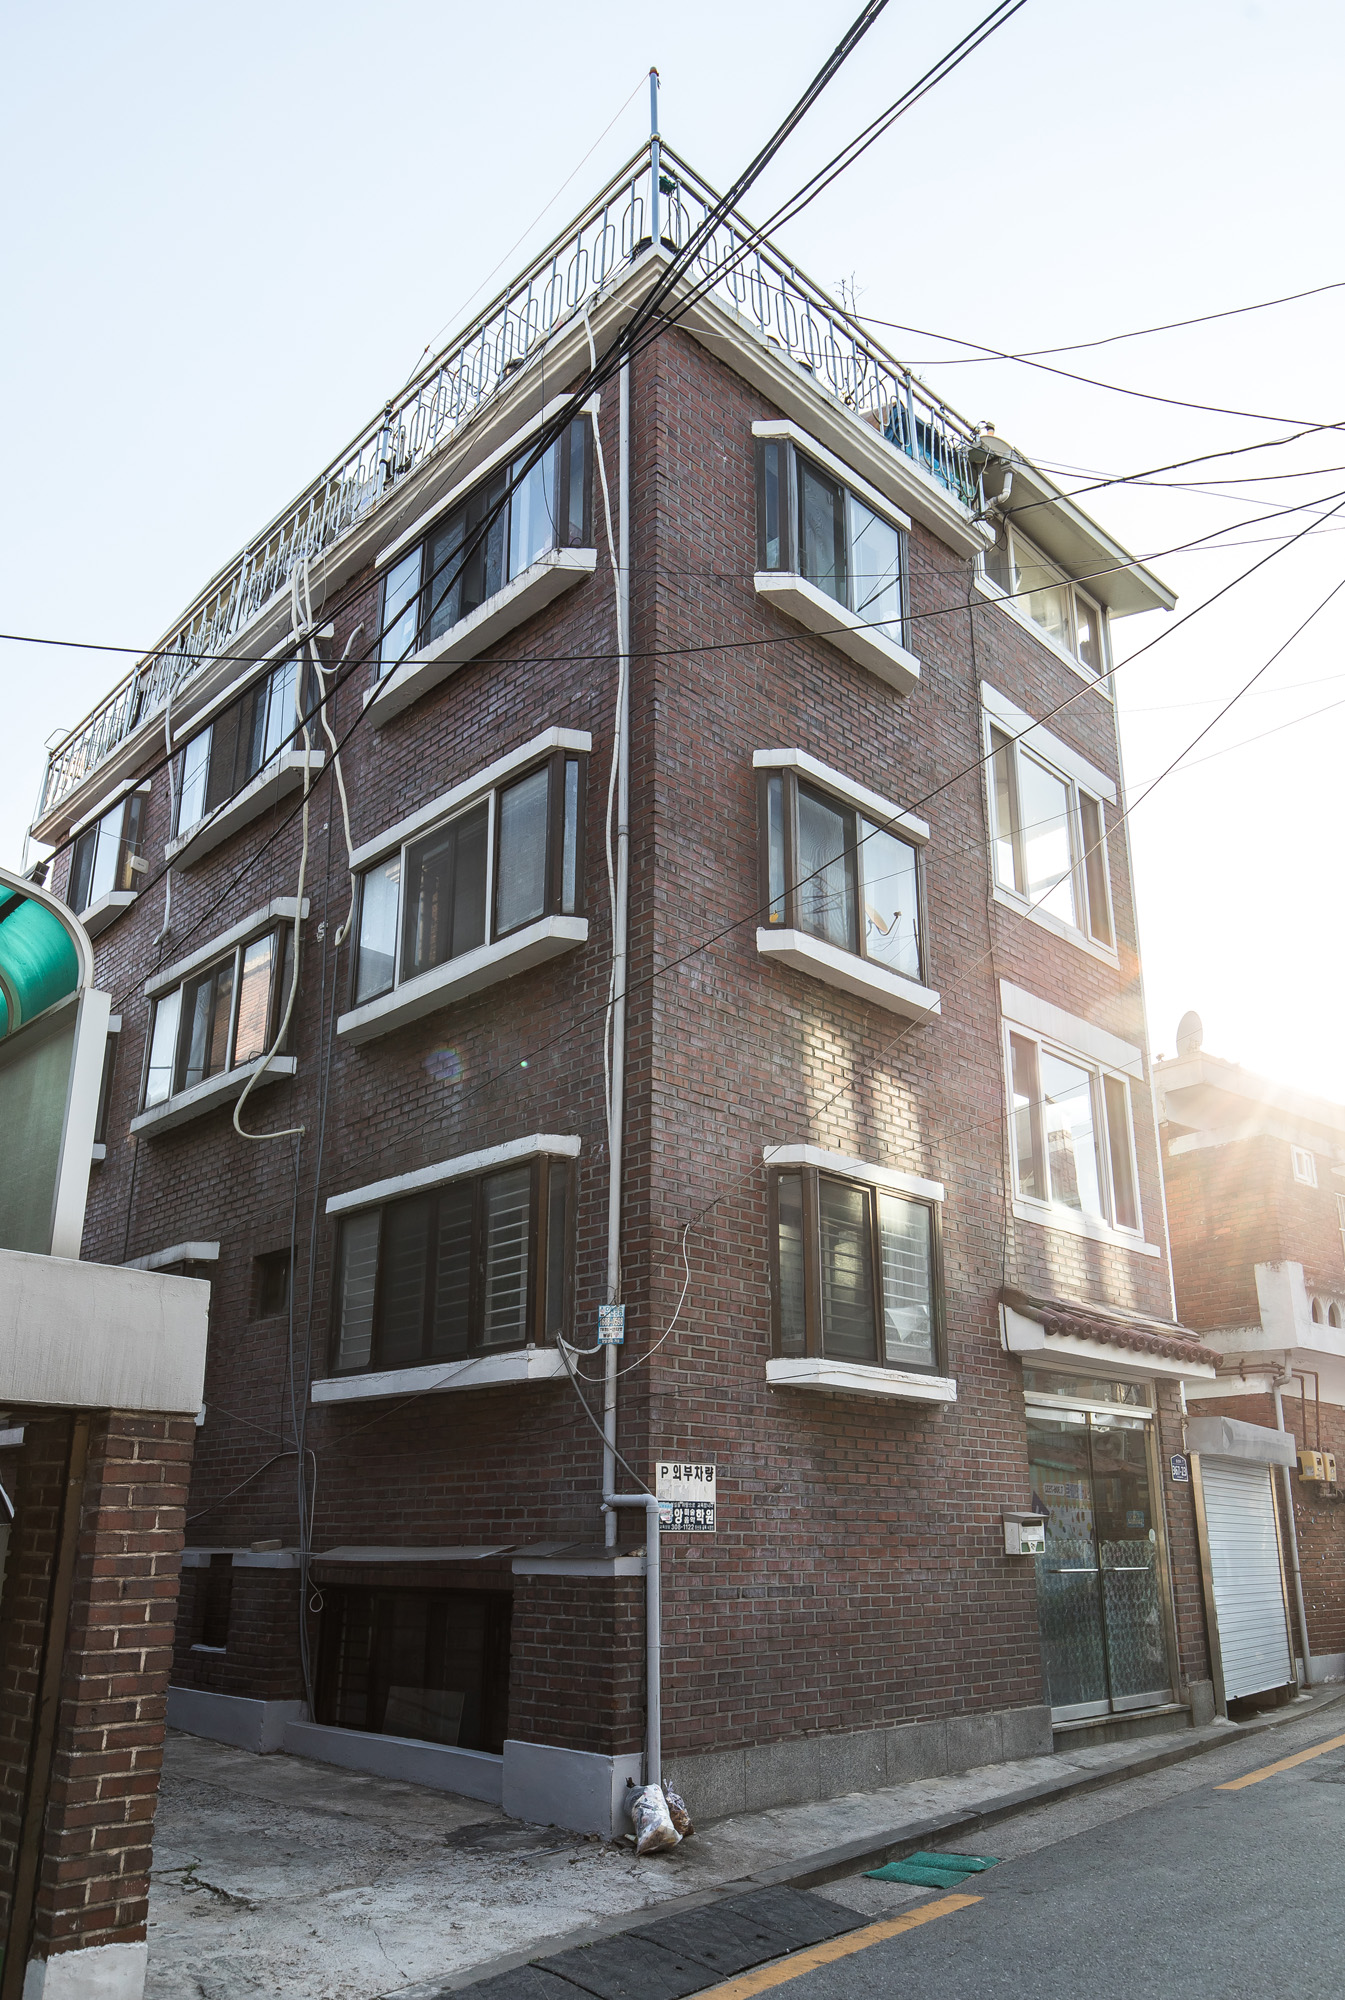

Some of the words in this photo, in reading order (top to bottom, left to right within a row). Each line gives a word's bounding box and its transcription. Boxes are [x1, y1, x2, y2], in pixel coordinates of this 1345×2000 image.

[661, 1466, 669, 1478] P
[673, 1465, 714, 1482] 외부차량
[696, 1509, 714, 1524] 학원
